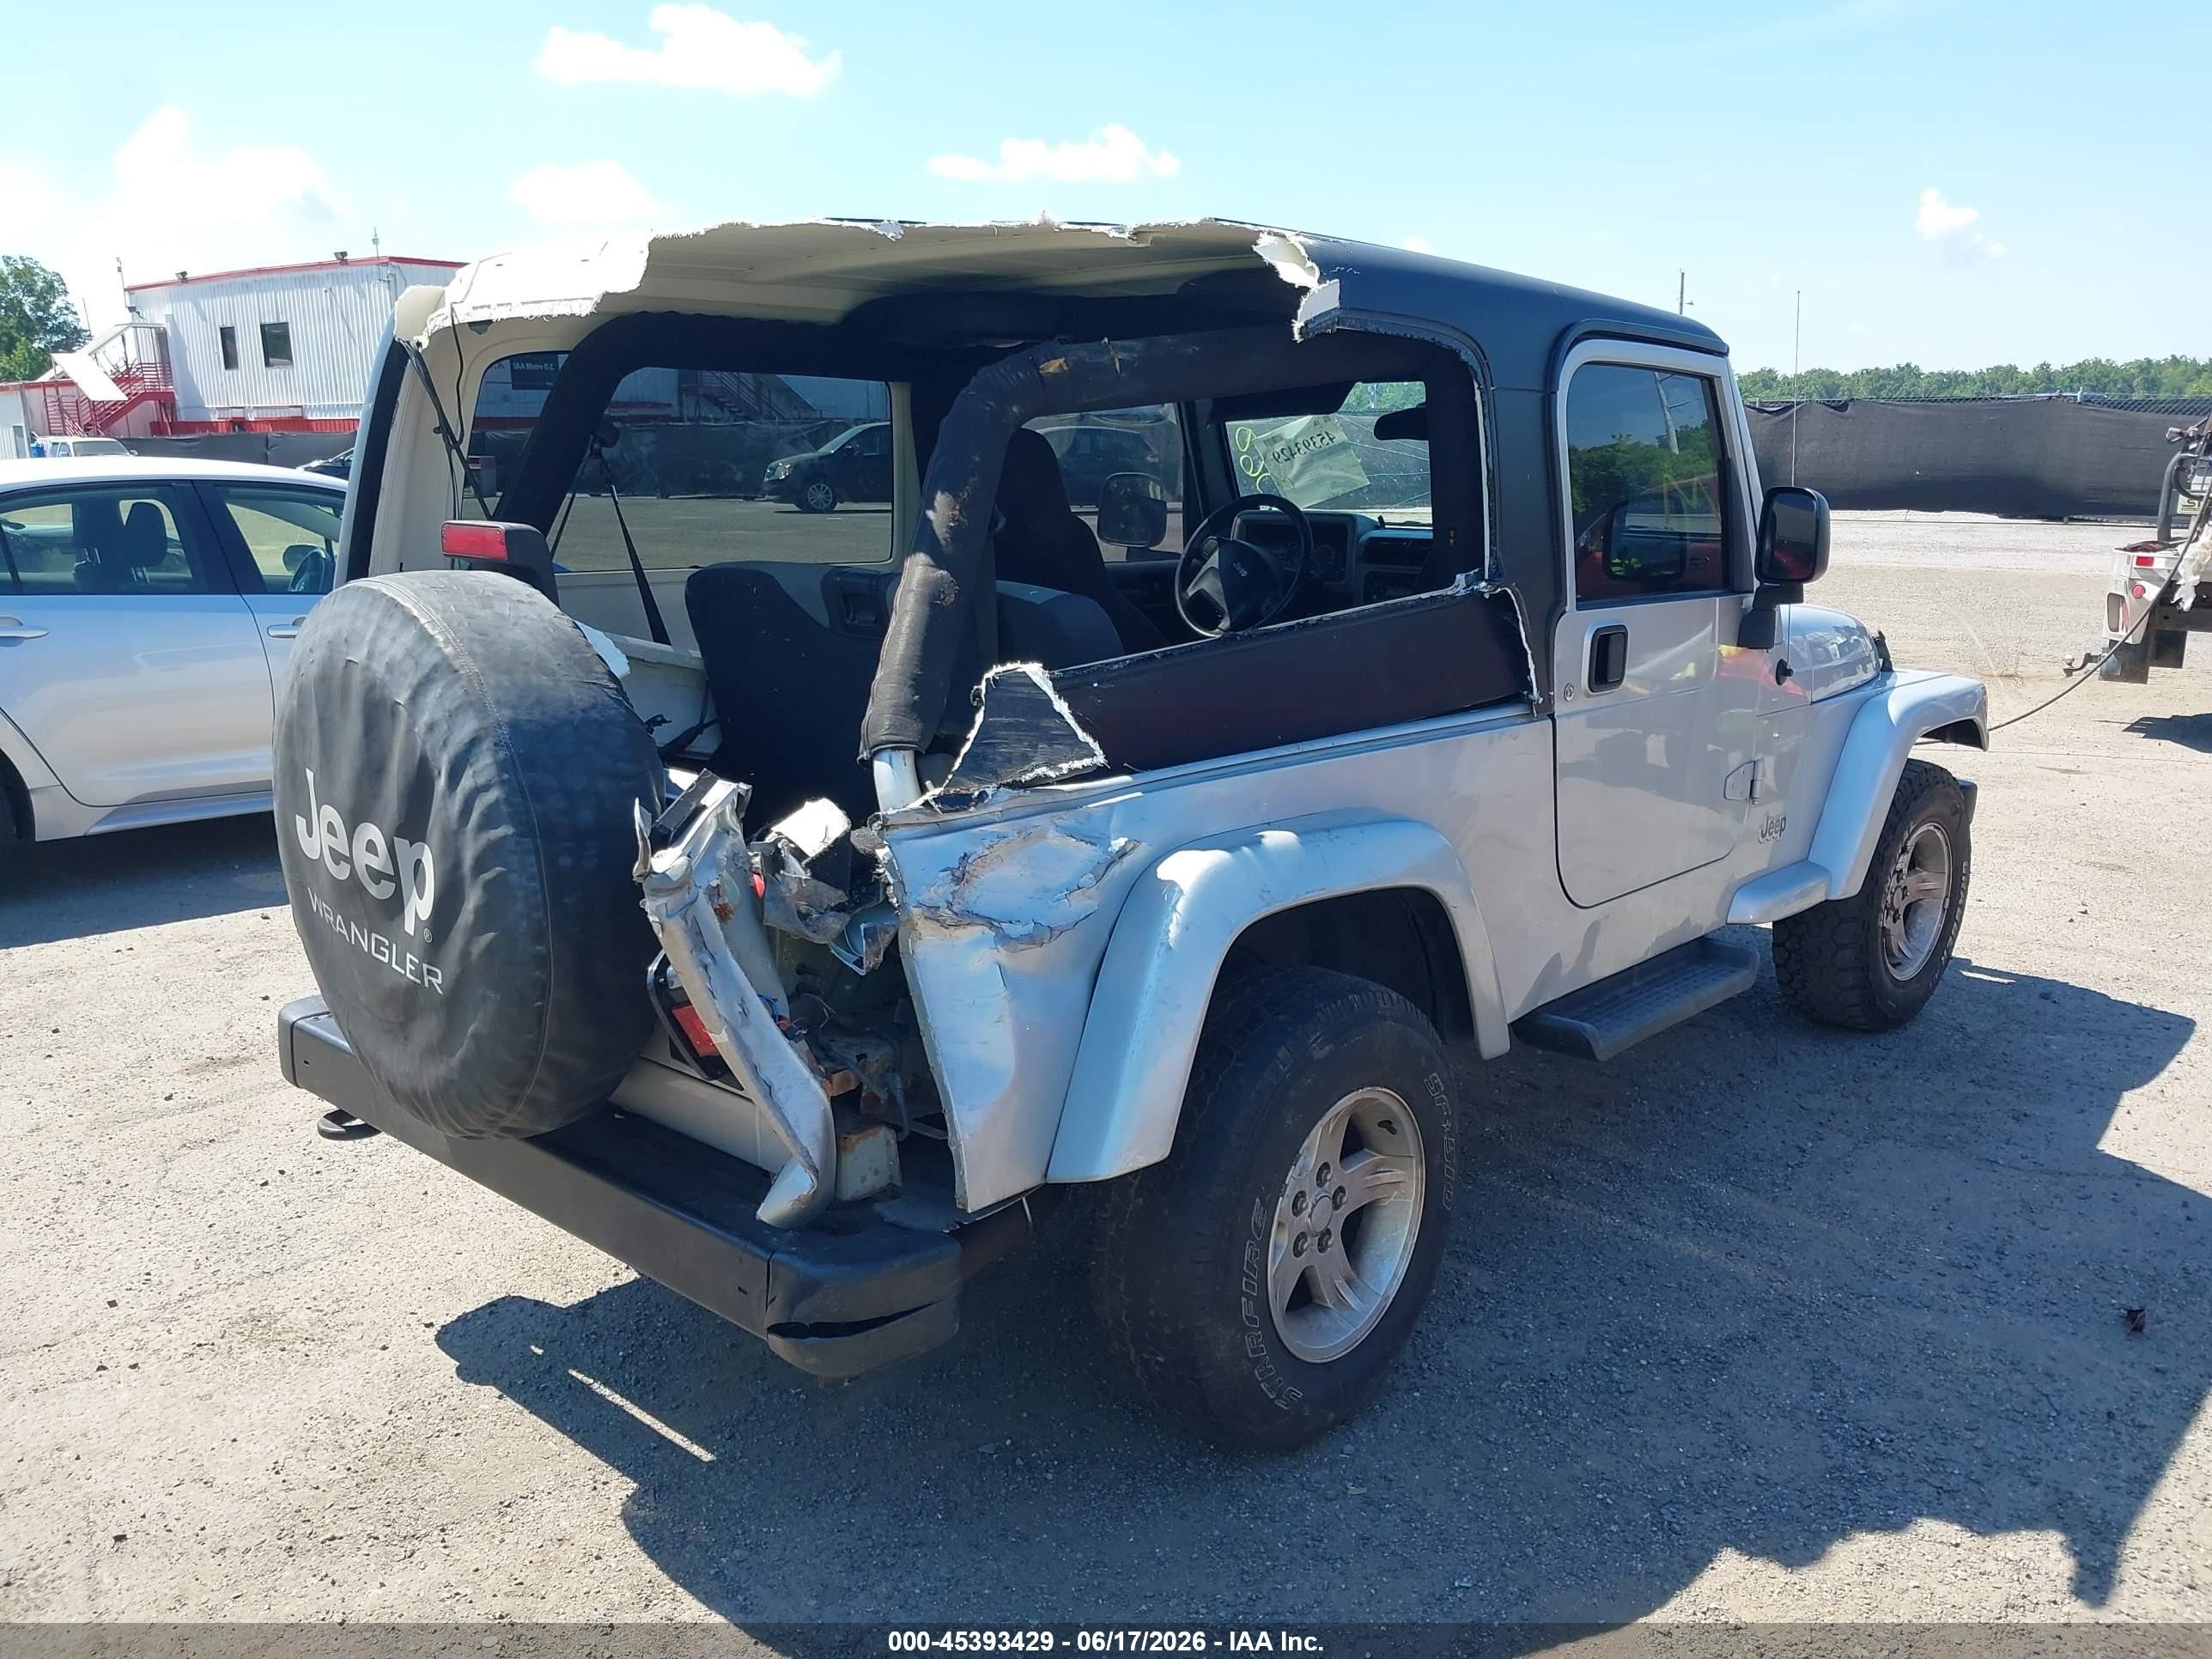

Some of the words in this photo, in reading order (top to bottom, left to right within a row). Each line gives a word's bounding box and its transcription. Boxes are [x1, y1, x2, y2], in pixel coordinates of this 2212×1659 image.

[514, 362, 525, 371] IAA
[296, 768, 434, 936] Jeep
[1760, 816, 1787, 839] Jeep
[307, 887, 444, 996] WRANGLER
[1242, 1197, 1304, 1410] STARFIRE
